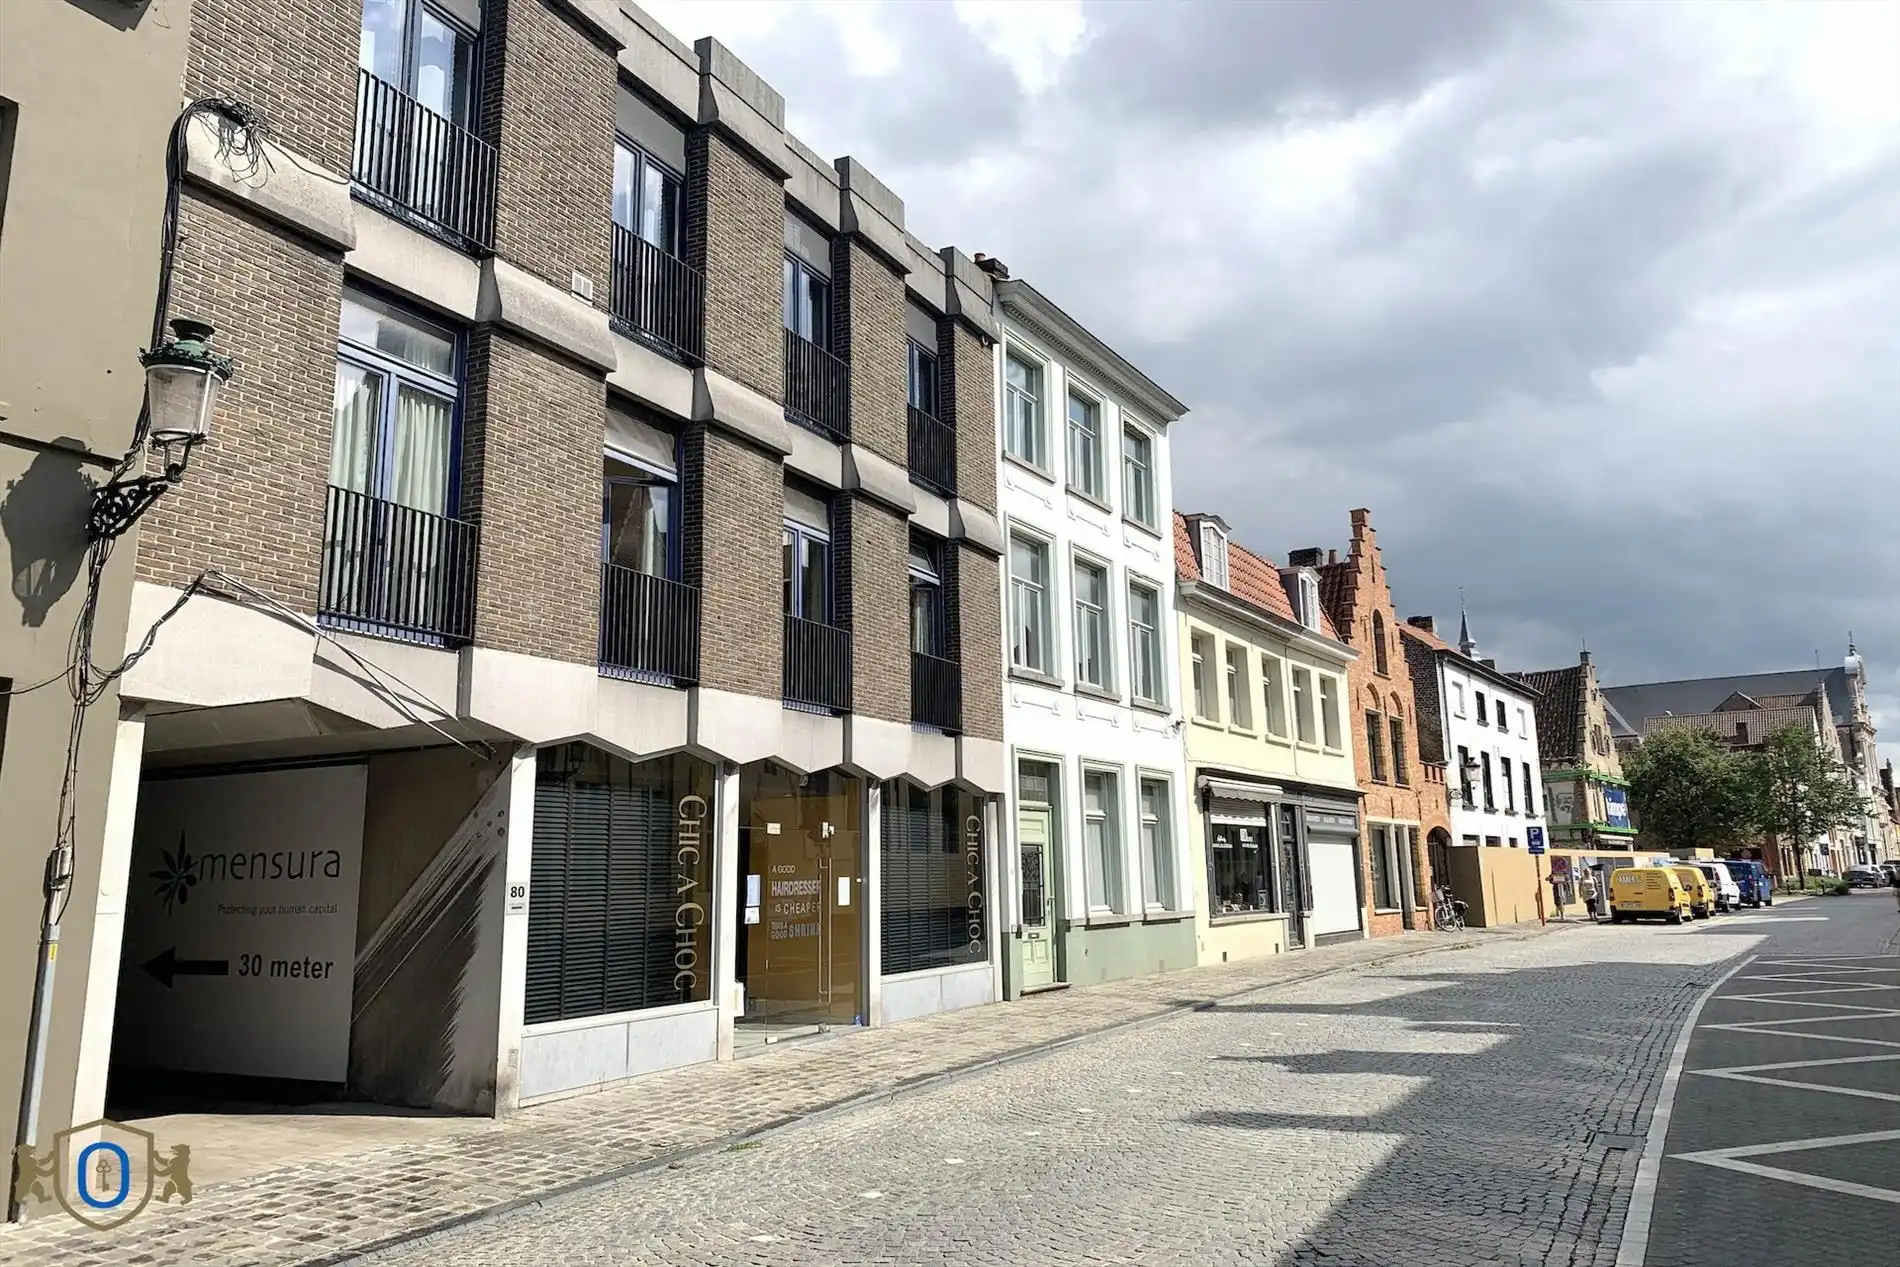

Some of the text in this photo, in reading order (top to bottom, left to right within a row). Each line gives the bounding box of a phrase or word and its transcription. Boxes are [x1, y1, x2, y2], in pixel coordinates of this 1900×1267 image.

[1530, 828, 1539, 839] P
[200, 850, 340, 882] mensura
[772, 865, 796, 874] A GOOD
[510, 886, 525, 898] 80
[674, 795, 708, 991] CHIC A CHOC
[966, 815, 983, 954] CHIC A CHOC
[309, 903, 338, 915] capital
[238, 954, 333, 979] 30 meter
